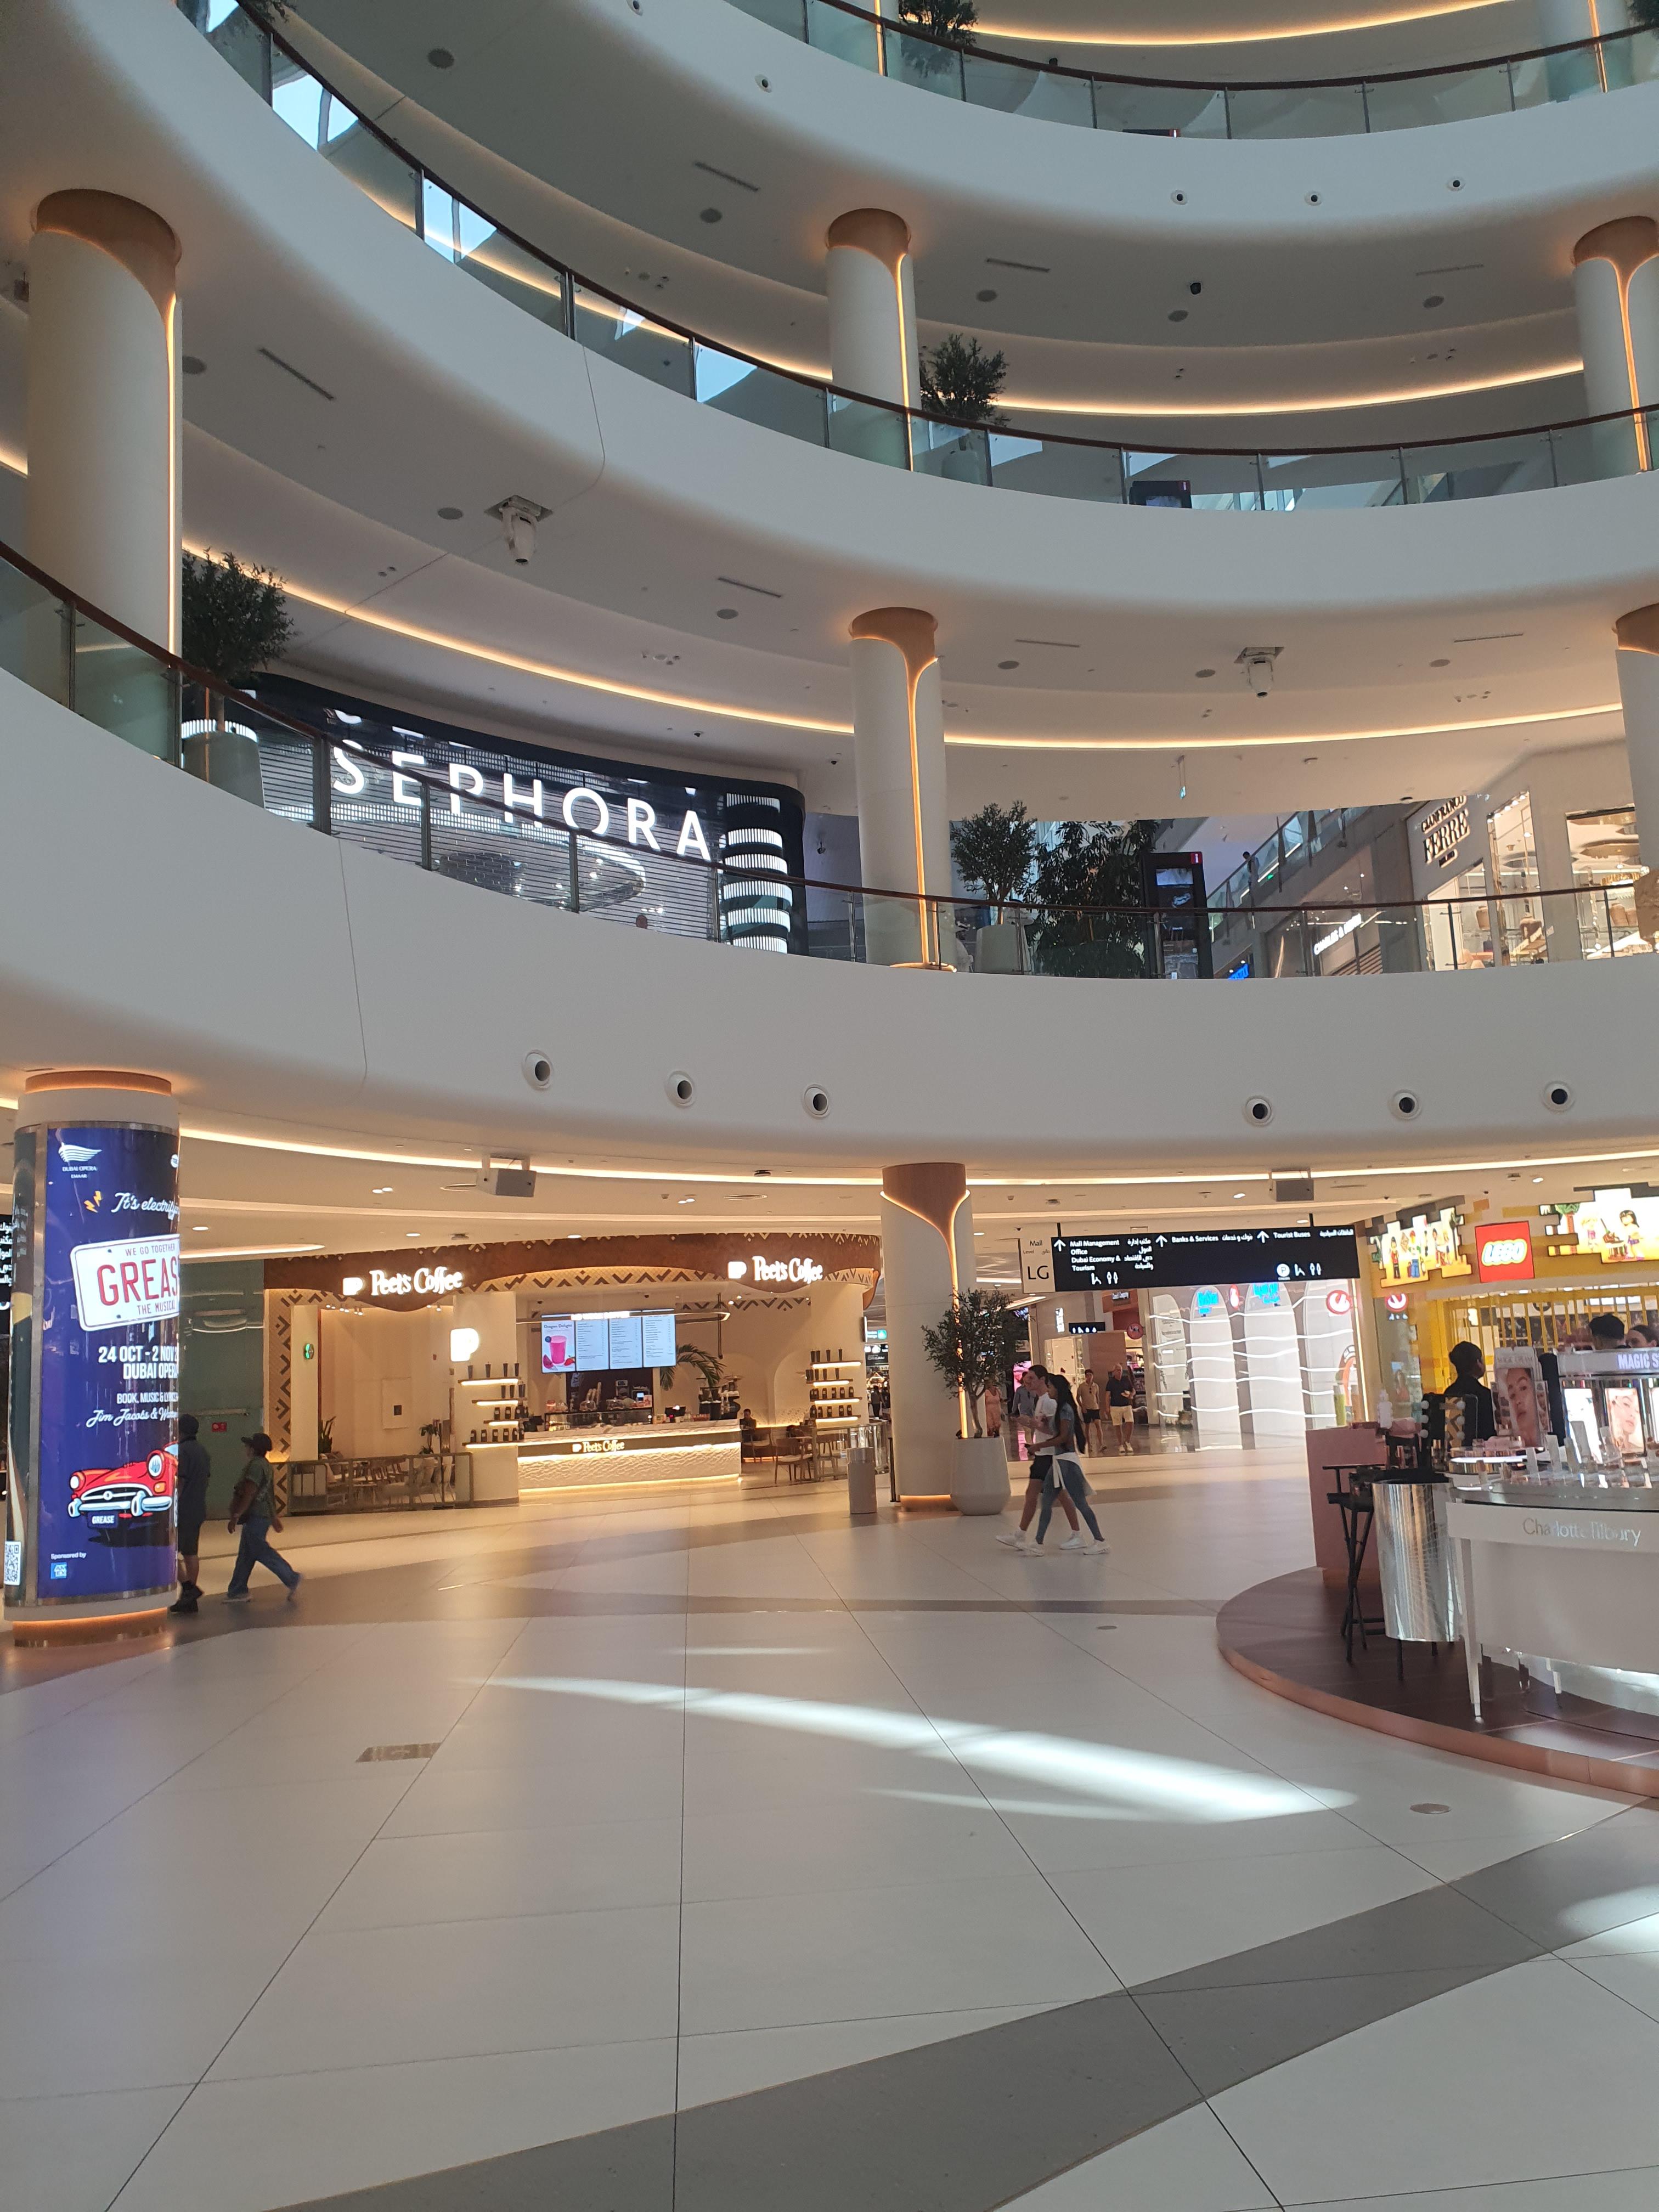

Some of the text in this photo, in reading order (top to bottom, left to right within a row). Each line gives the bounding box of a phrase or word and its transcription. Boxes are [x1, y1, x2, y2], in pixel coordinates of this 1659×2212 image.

[332, 739, 713, 862] SEPHORA
[111, 1192, 140, 1212] It's
[125, 1243, 175, 1256] WE GO TOGETHER
[1083, 1239, 1120, 1248] Management
[1482, 1239, 1527, 1265] LEGO
[789, 1257, 823, 1284] Coffee
[1028, 1265, 1049, 1279] LG
[369, 1266, 463, 1296] Peet's Coffee
[137, 1304, 152, 1315] THE
[98, 1346, 117, 1363] 24
[119, 1345, 144, 1362] OCT
[152, 1345, 159, 1362] 2
[160, 1345, 174, 1362] NOV
[1617, 1353, 1650, 1370] MAGIC
[123, 1363, 157, 1379] DUBAI
[116, 1392, 139, 1404] BOOK,
[140, 1392, 159, 1403] MUSIC
[86, 1409, 113, 1427] Jim
[113, 1408, 149, 1426] Jacobs
[150, 1407, 158, 1419] &
[602, 1440, 625, 1452] Coffee
[92, 1515, 115, 1525] GREASE
[1522, 1517, 1588, 1538] Chalotte
